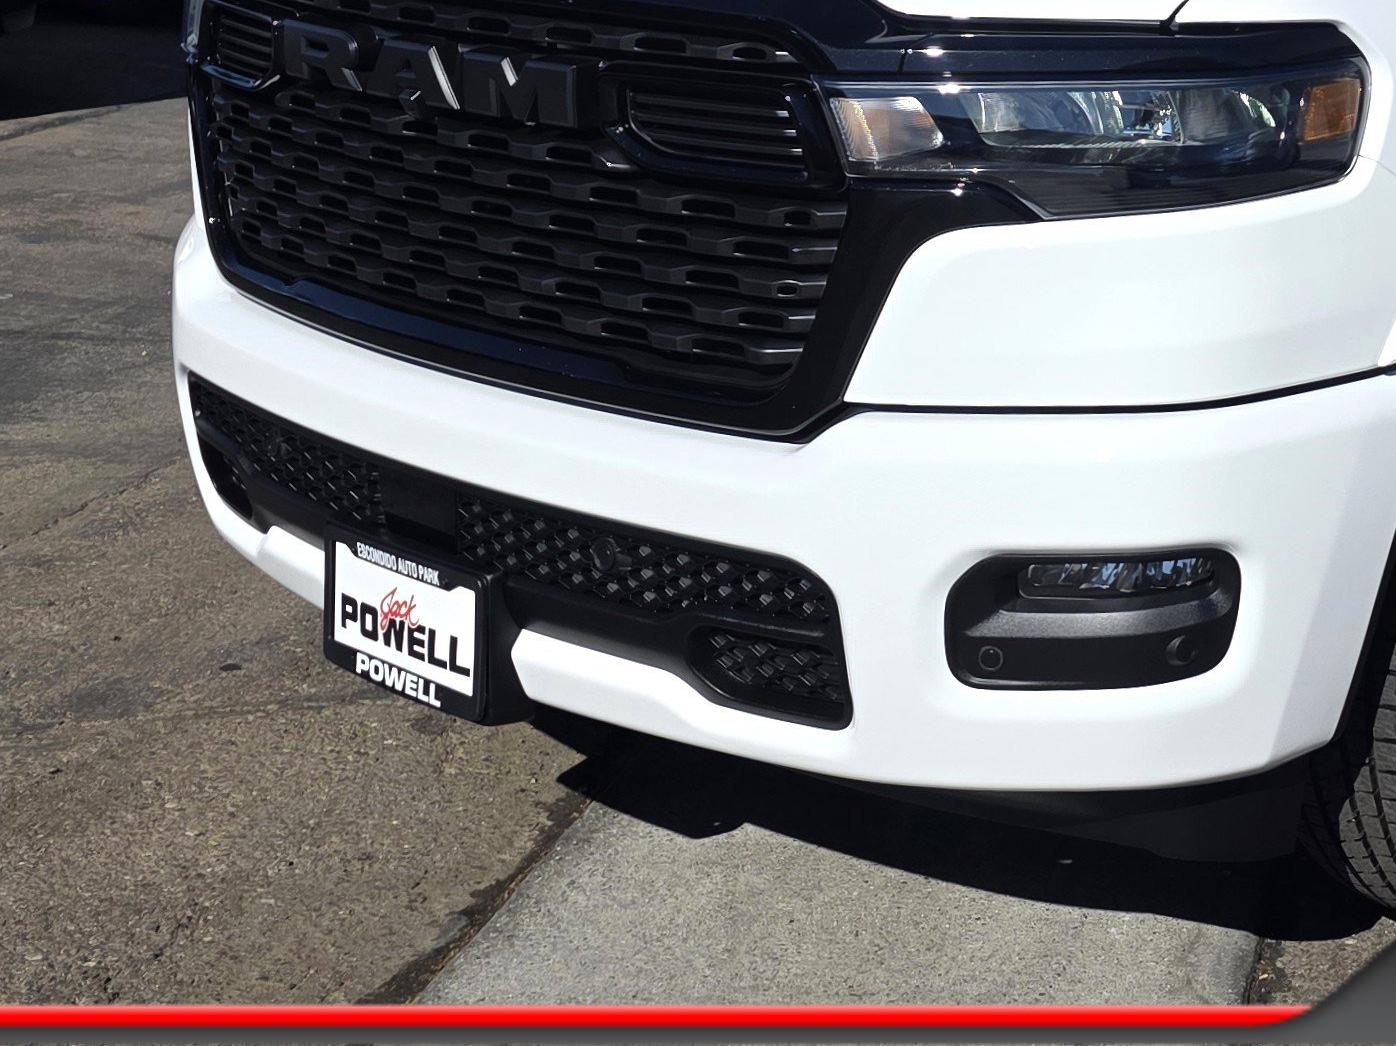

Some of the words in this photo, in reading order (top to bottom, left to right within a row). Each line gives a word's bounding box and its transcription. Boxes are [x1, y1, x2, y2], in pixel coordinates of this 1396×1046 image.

[281, 18, 579, 128] RAM
[356, 542, 397, 571] ESCONDIDO
[398, 557, 418, 578] AUTO
[418, 565, 441, 586] PARK
[341, 592, 471, 678] POWELL
[380, 587, 420, 632] Jack
[355, 652, 442, 708] POWELL
